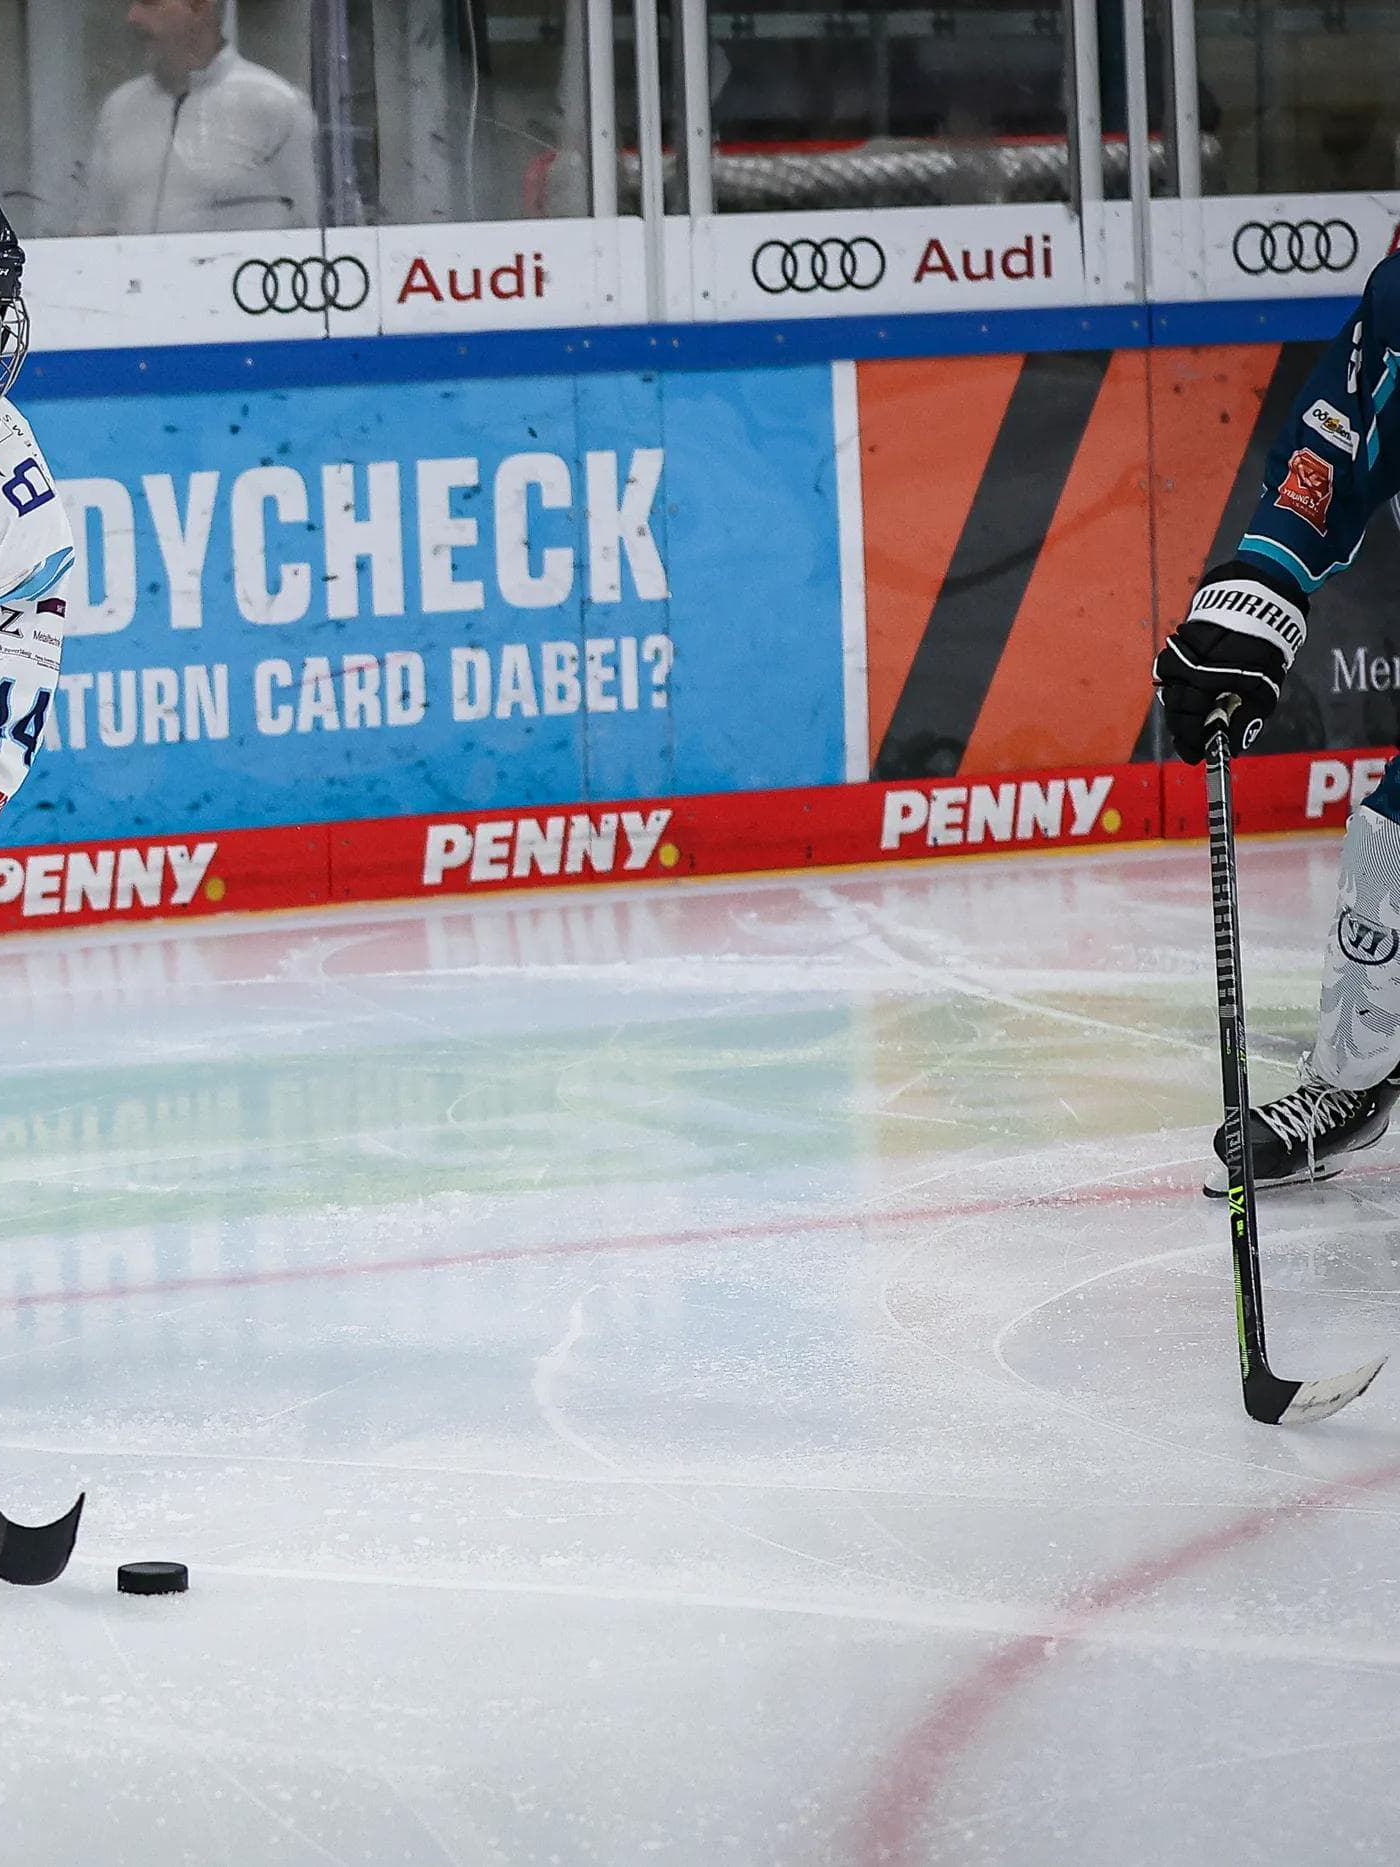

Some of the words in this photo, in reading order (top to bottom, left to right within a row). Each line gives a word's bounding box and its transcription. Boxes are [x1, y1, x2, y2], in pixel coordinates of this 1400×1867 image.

[398, 252, 544, 303] Audi
[914, 234, 1052, 284] Audi
[254, 651, 426, 736] CARD
[451, 632, 674, 723] DABEI?
